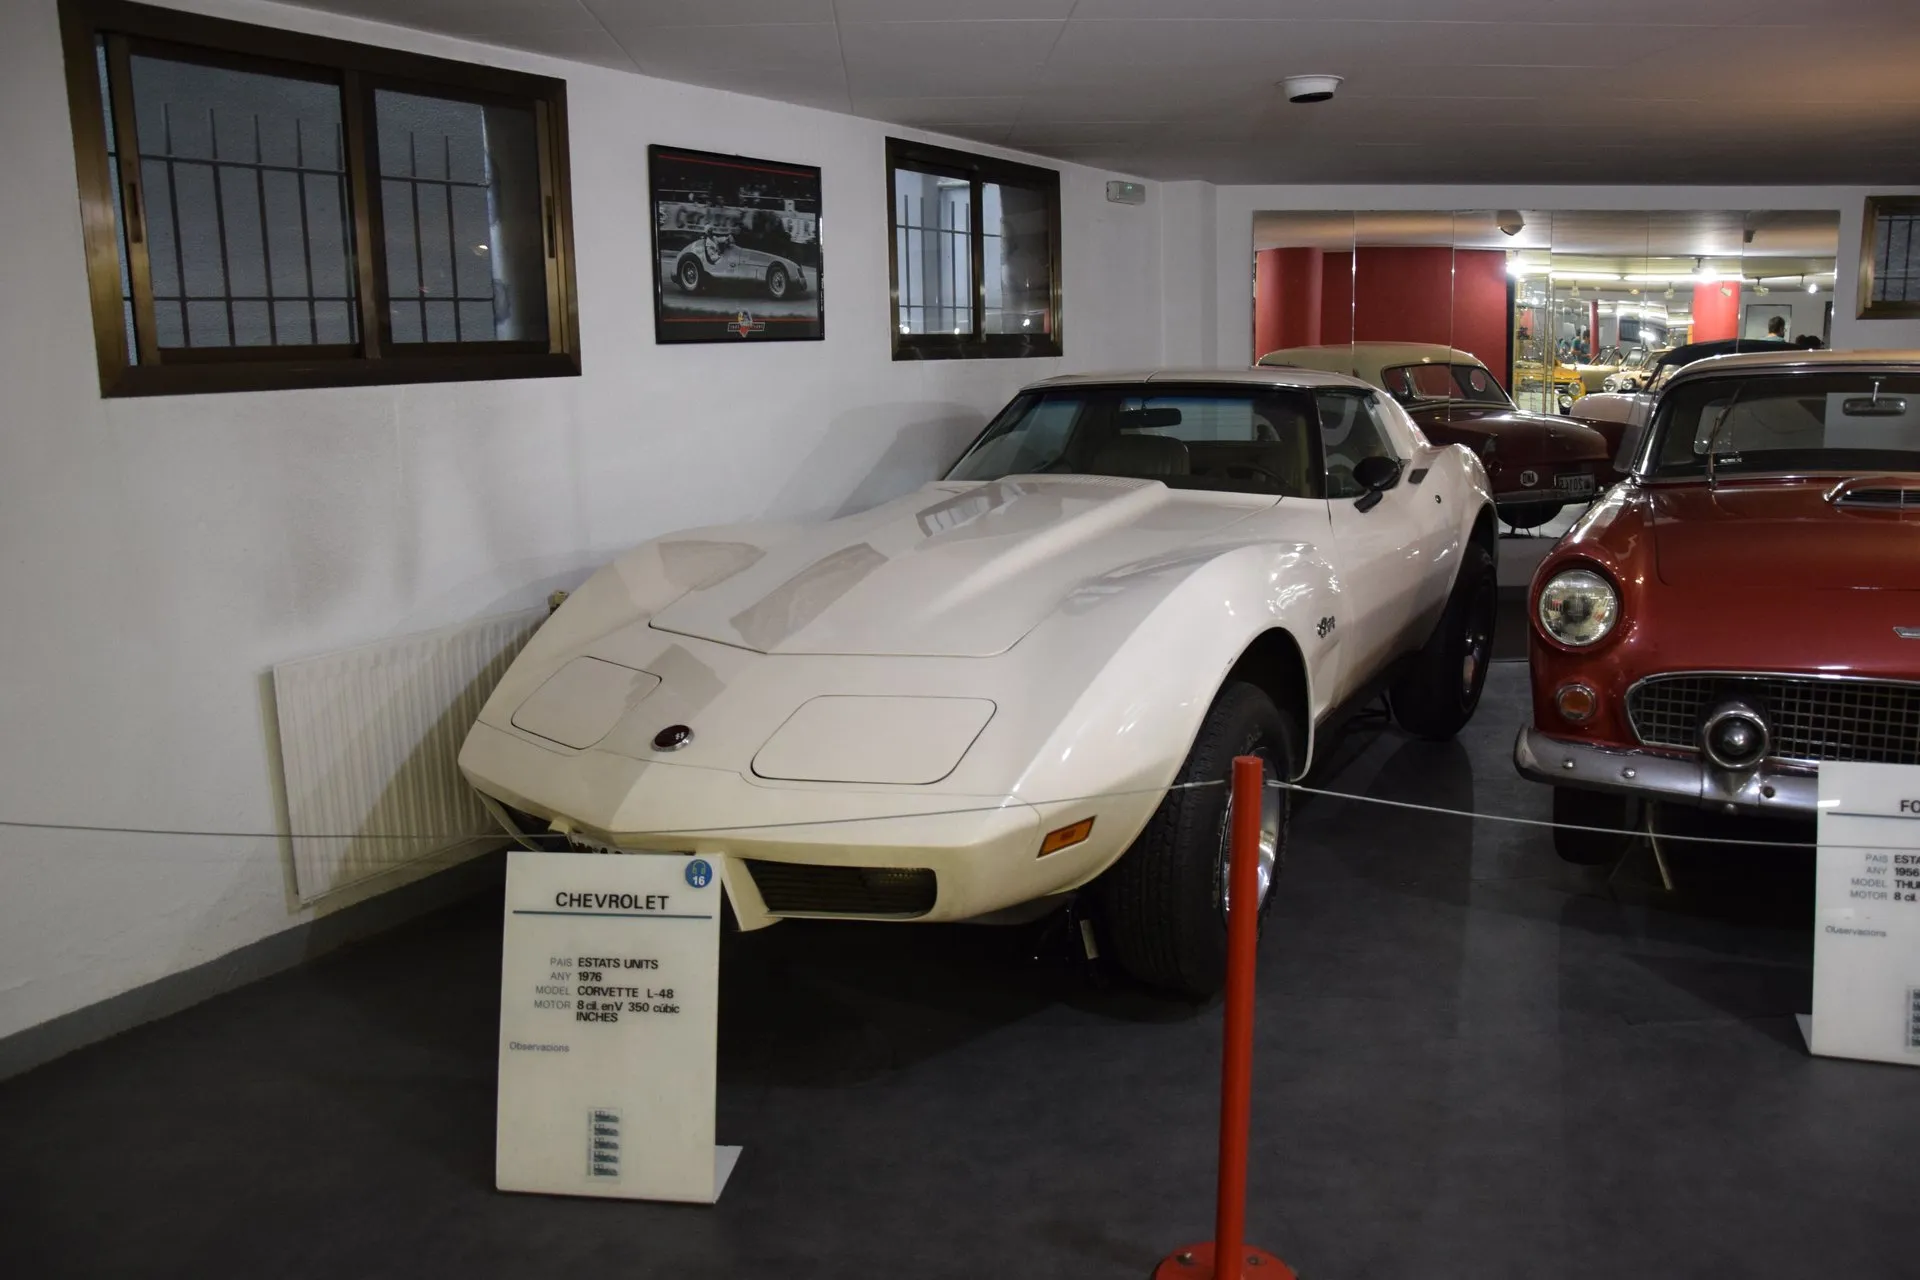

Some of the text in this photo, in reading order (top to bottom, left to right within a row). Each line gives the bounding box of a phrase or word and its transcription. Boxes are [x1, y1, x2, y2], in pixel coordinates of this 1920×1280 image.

[1866, 866, 1920, 877] ANY 1956
[693, 875, 705, 886] 16
[1851, 878, 1888, 888] MODEL
[555, 891, 670, 910] CHEVROLET
[1850, 890, 1888, 900] MOTOR
[1894, 891, 1902, 901] 8
[578, 957, 620, 969] ESTATS
[624, 958, 659, 970] UNITS
[550, 971, 602, 982] ANY 1976
[535, 985, 674, 999] MODEL CORVETTE L-48
[534, 999, 571, 1010] MOTOR
[576, 1000, 585, 1010] 8
[628, 1003, 650, 1013] 350
[576, 1011, 618, 1023] INCHES
[509, 1041, 570, 1053] Observacions
